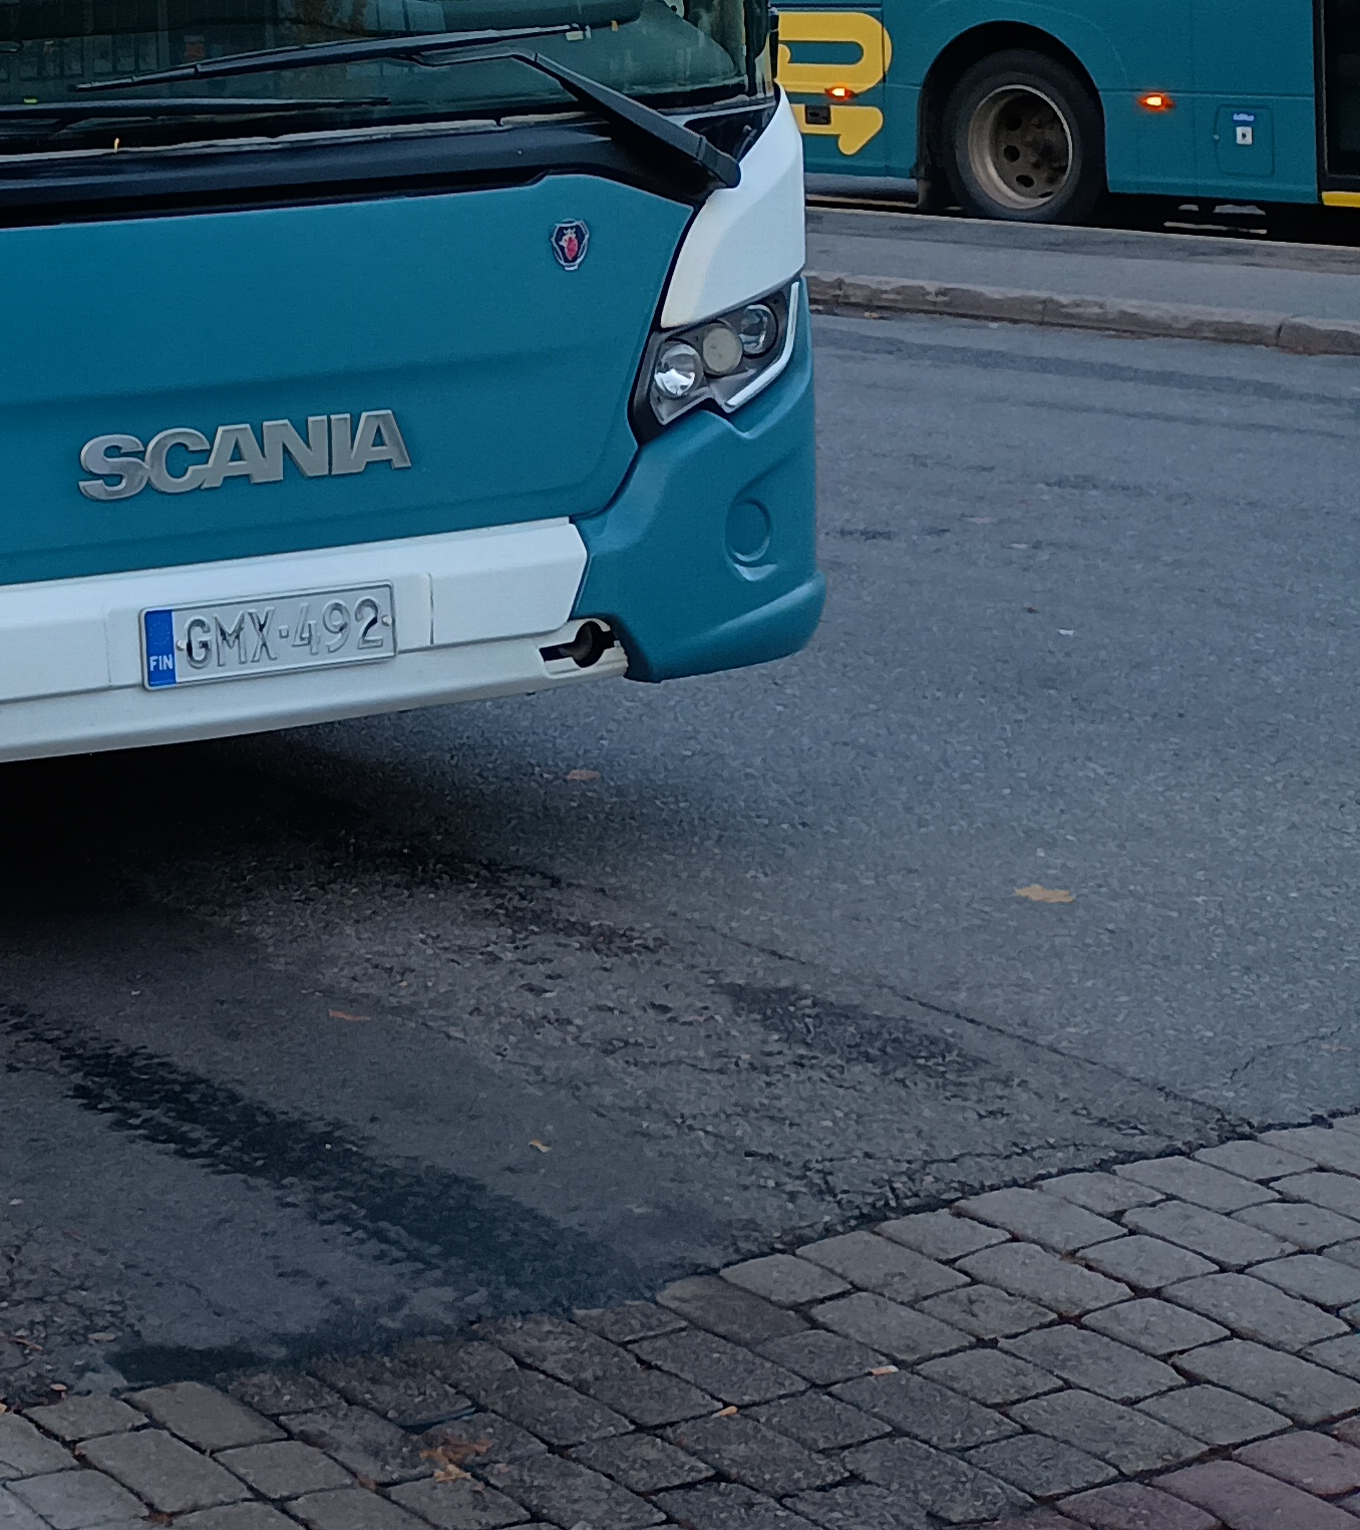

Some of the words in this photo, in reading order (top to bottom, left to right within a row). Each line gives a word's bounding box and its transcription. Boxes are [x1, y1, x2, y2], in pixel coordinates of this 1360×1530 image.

[78, 408, 412, 502] SCANIA
[148, 653, 174, 674] FIN
[183, 595, 384, 671] GMX-492
